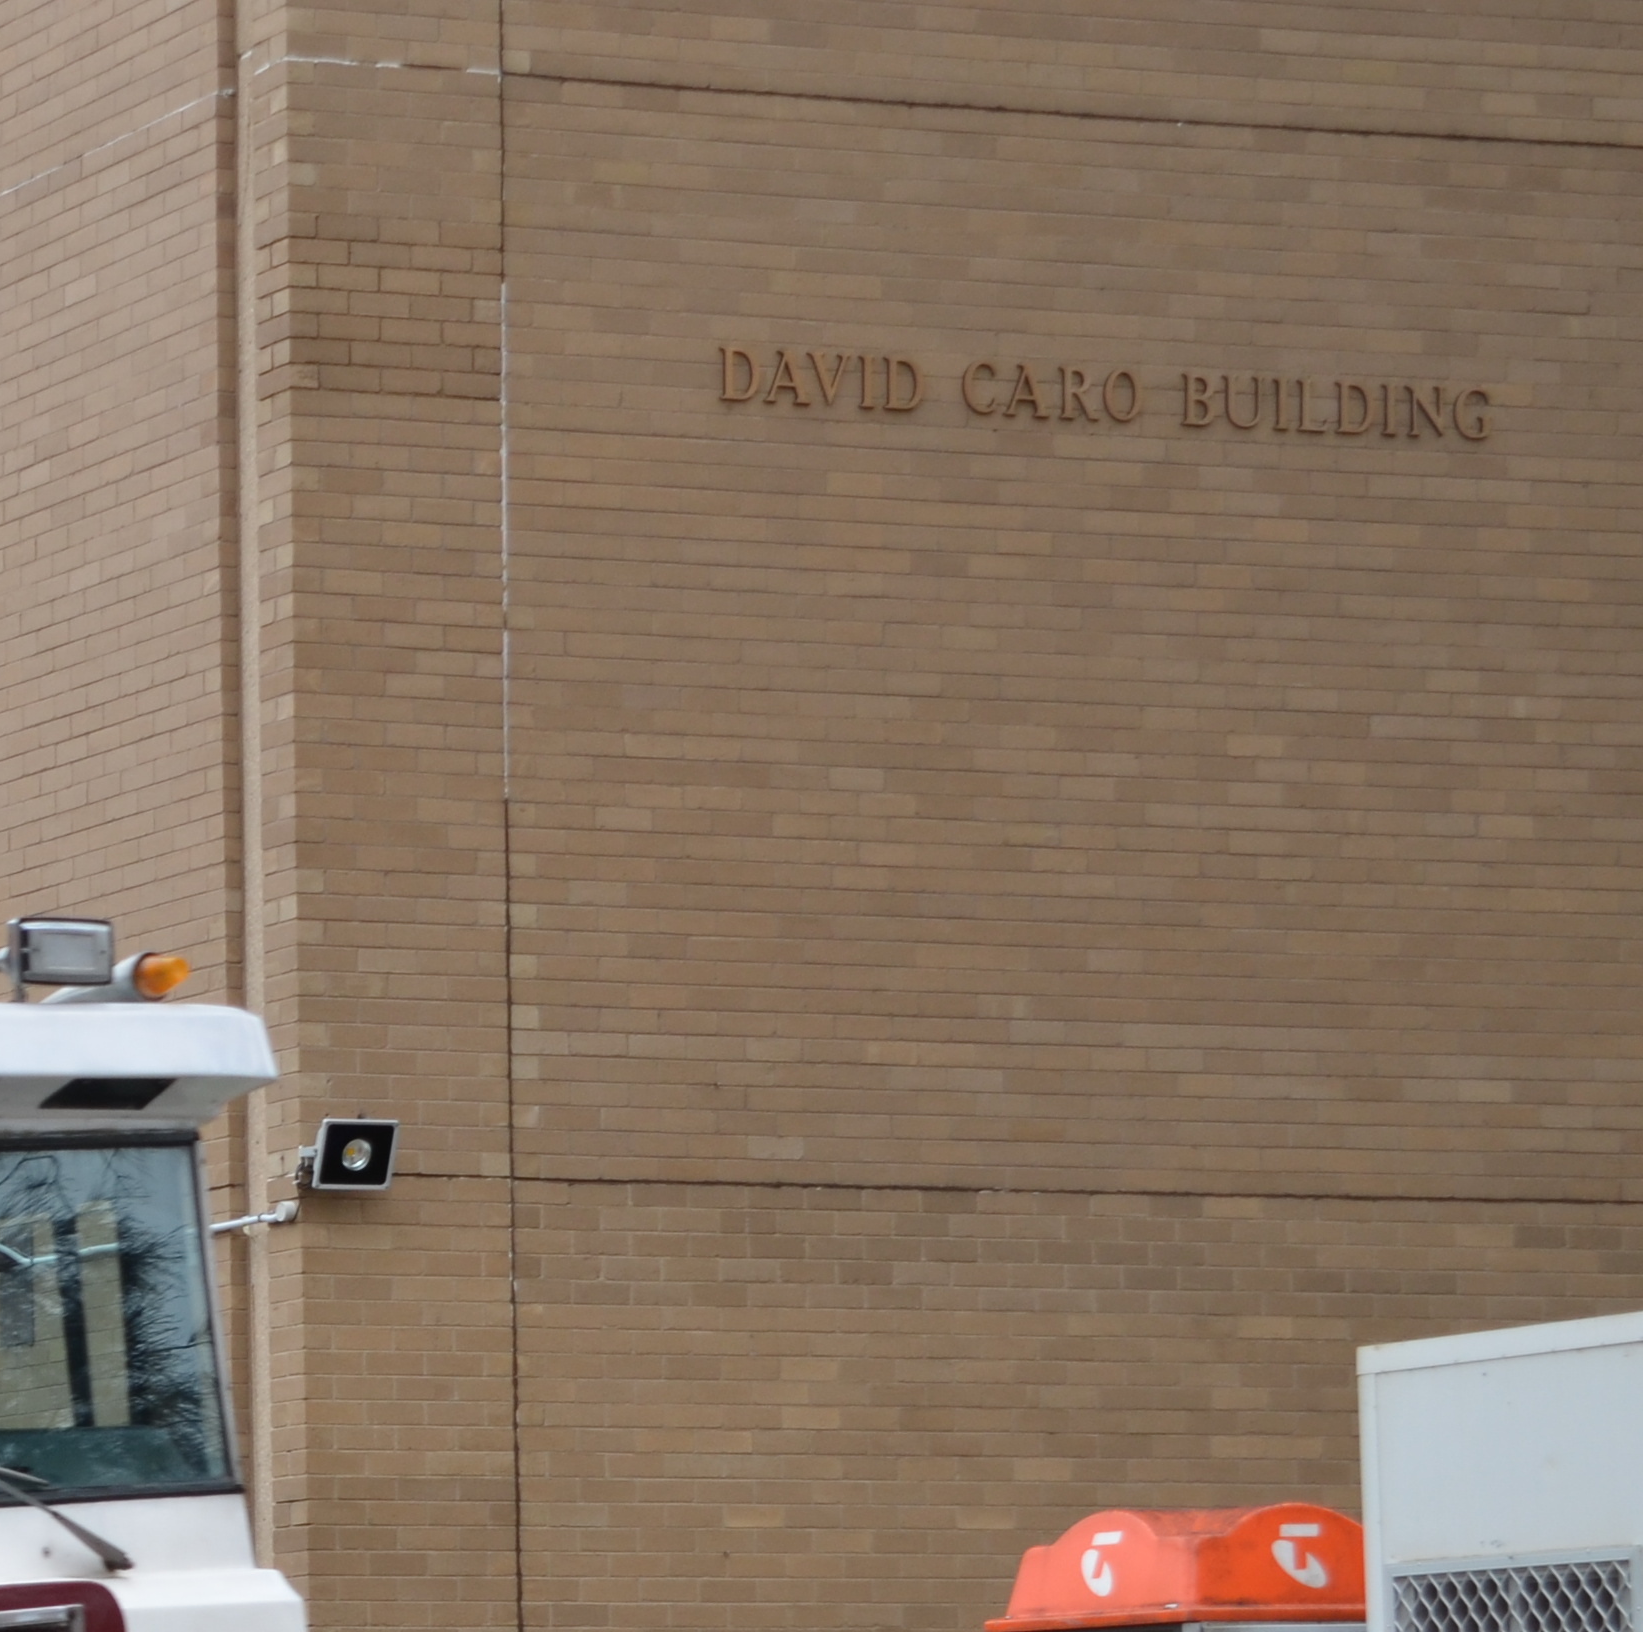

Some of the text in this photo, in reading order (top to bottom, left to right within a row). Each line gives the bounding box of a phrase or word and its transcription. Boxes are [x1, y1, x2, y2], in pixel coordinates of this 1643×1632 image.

[718, 346, 1493, 442] DAVID CARO BUILDING
